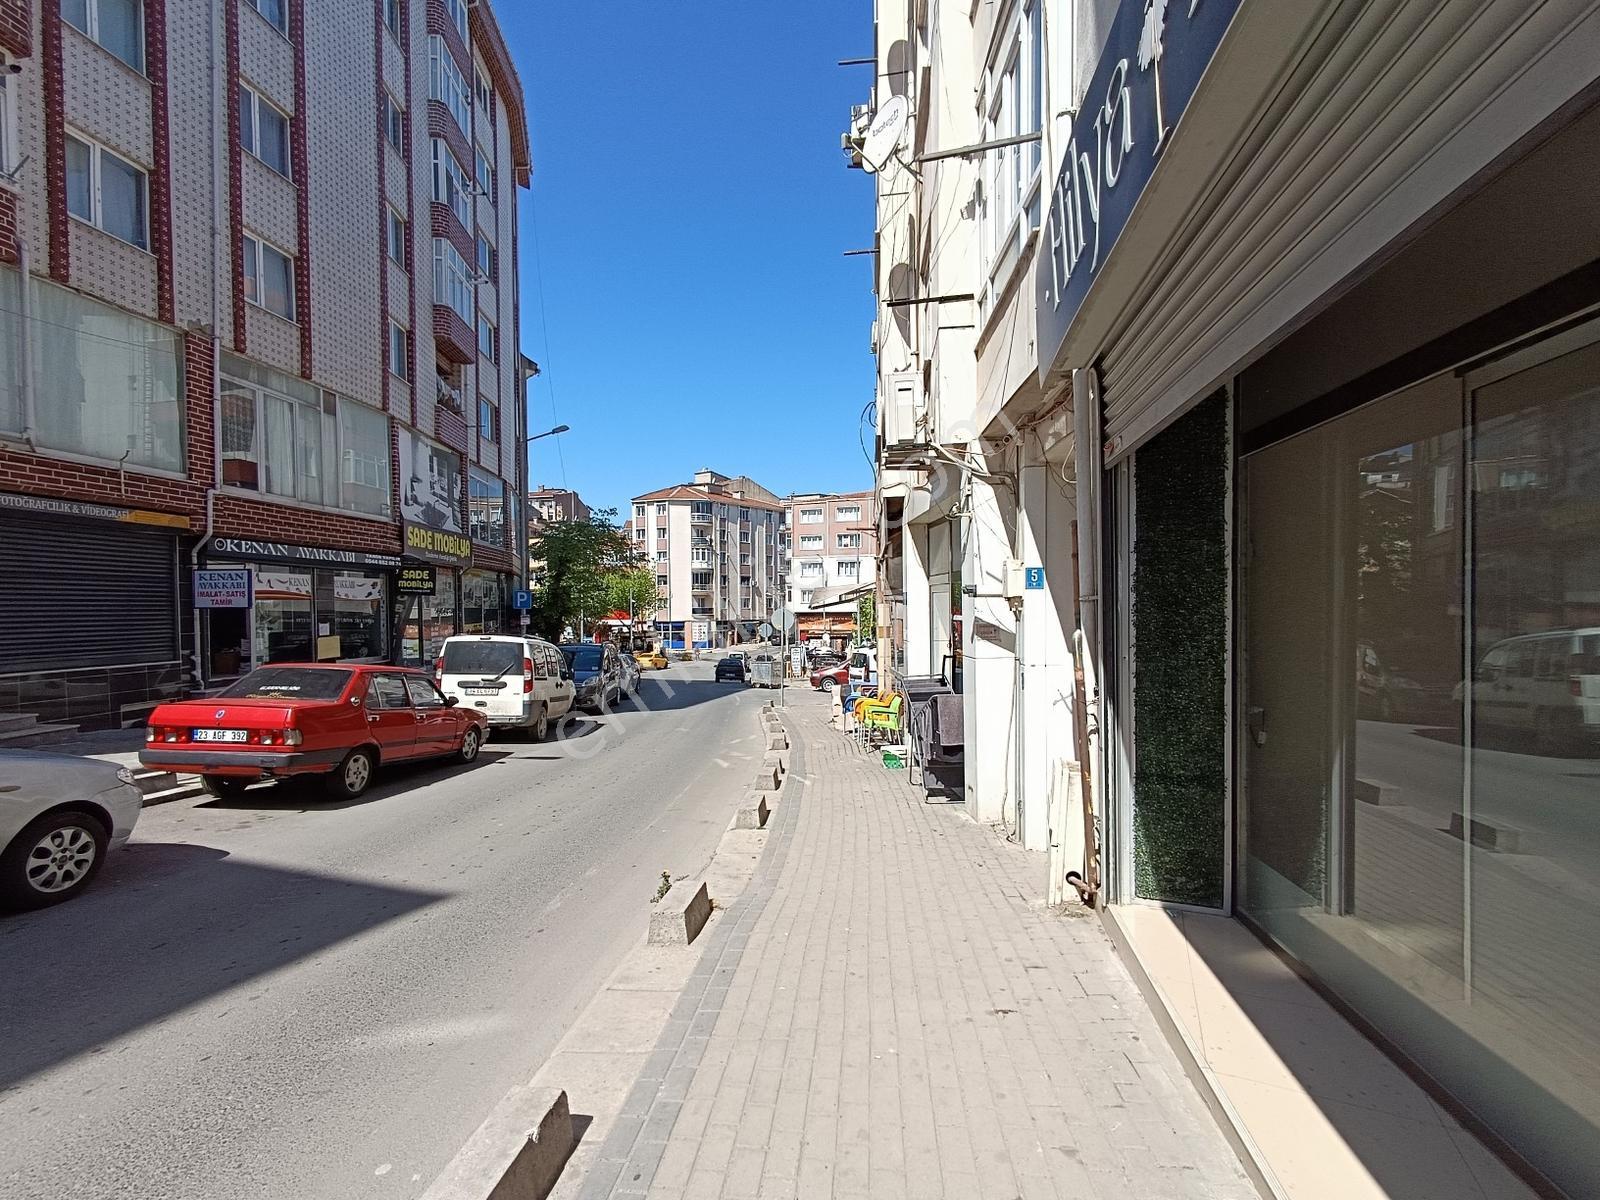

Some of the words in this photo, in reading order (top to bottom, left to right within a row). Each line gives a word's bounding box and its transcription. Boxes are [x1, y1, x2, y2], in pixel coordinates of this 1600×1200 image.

[0, 495, 71, 512] OTOĞRAFCILIK
[72, 504, 80, 514] &
[407, 526, 433, 550] SADE
[225, 539, 288, 556] KENAN
[296, 546, 356, 562] AYAKKABI
[198, 573, 244, 581] KENAN
[402, 570, 430, 579] SADE
[1031, 569, 1038, 582] 5
[210, 598, 233, 606] TAMİR
[517, 592, 528, 607] P
[198, 730, 208, 740] 23
[231, 731, 246, 741] 392
